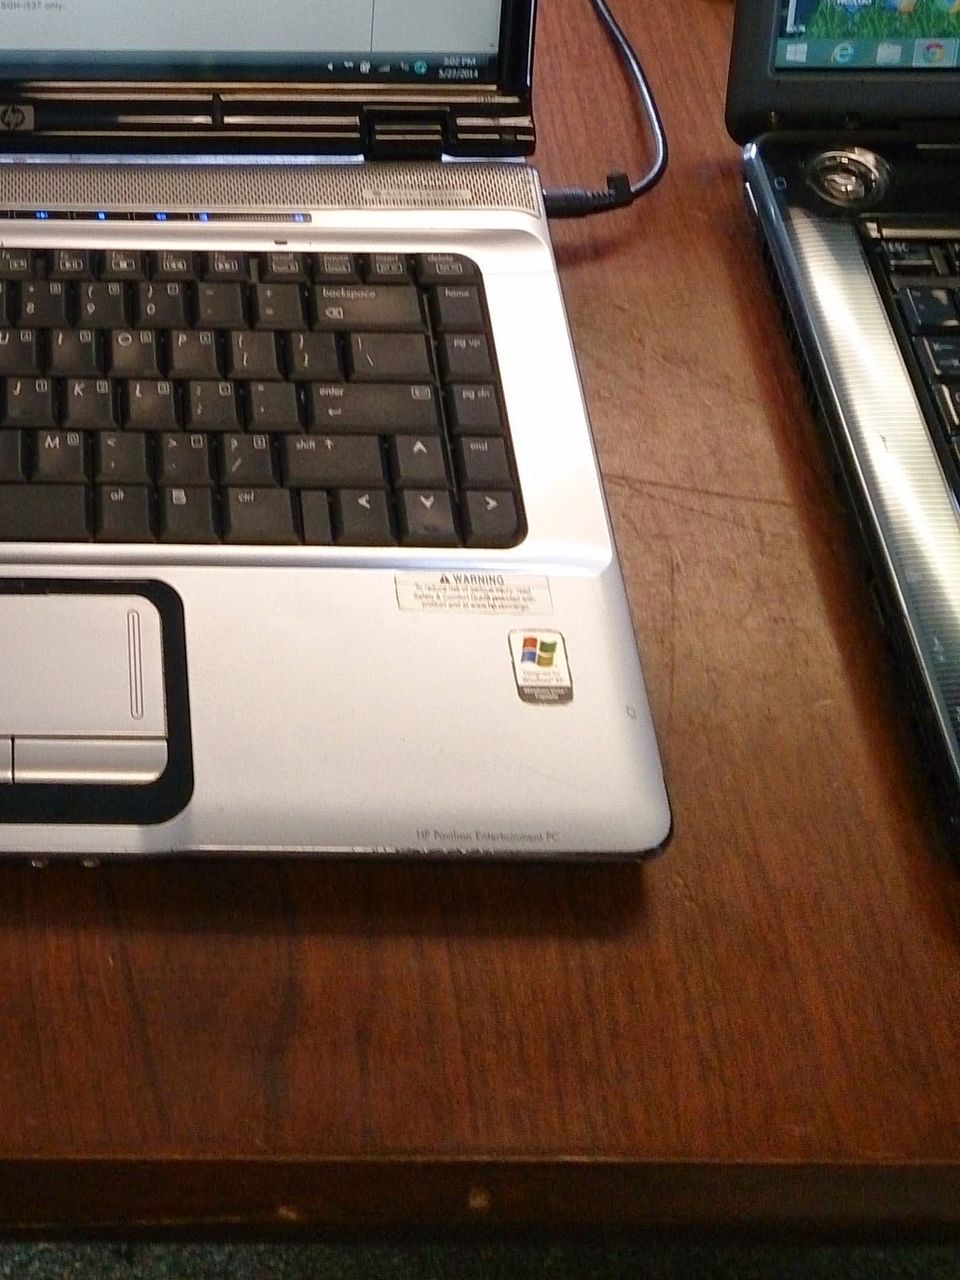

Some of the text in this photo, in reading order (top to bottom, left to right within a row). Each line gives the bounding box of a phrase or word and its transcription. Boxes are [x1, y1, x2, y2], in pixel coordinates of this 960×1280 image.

[322, 288, 376, 300] backspace
[445, 289, 470, 297] home
[118, 333, 132, 346] O
[178, 334, 187, 347] P
[13, 382, 21, 395] J
[74, 382, 86, 396] K
[135, 385, 142, 398] L
[320, 386, 344, 397] enter
[44, 435, 60, 448] M
[296, 439, 316, 450] shift
[470, 441, 488, 451] end
[110, 489, 125, 502] alt
[453, 574, 505, 586] WARNING
[416, 828, 559, 842] HP Pavilion Entertainment PC
